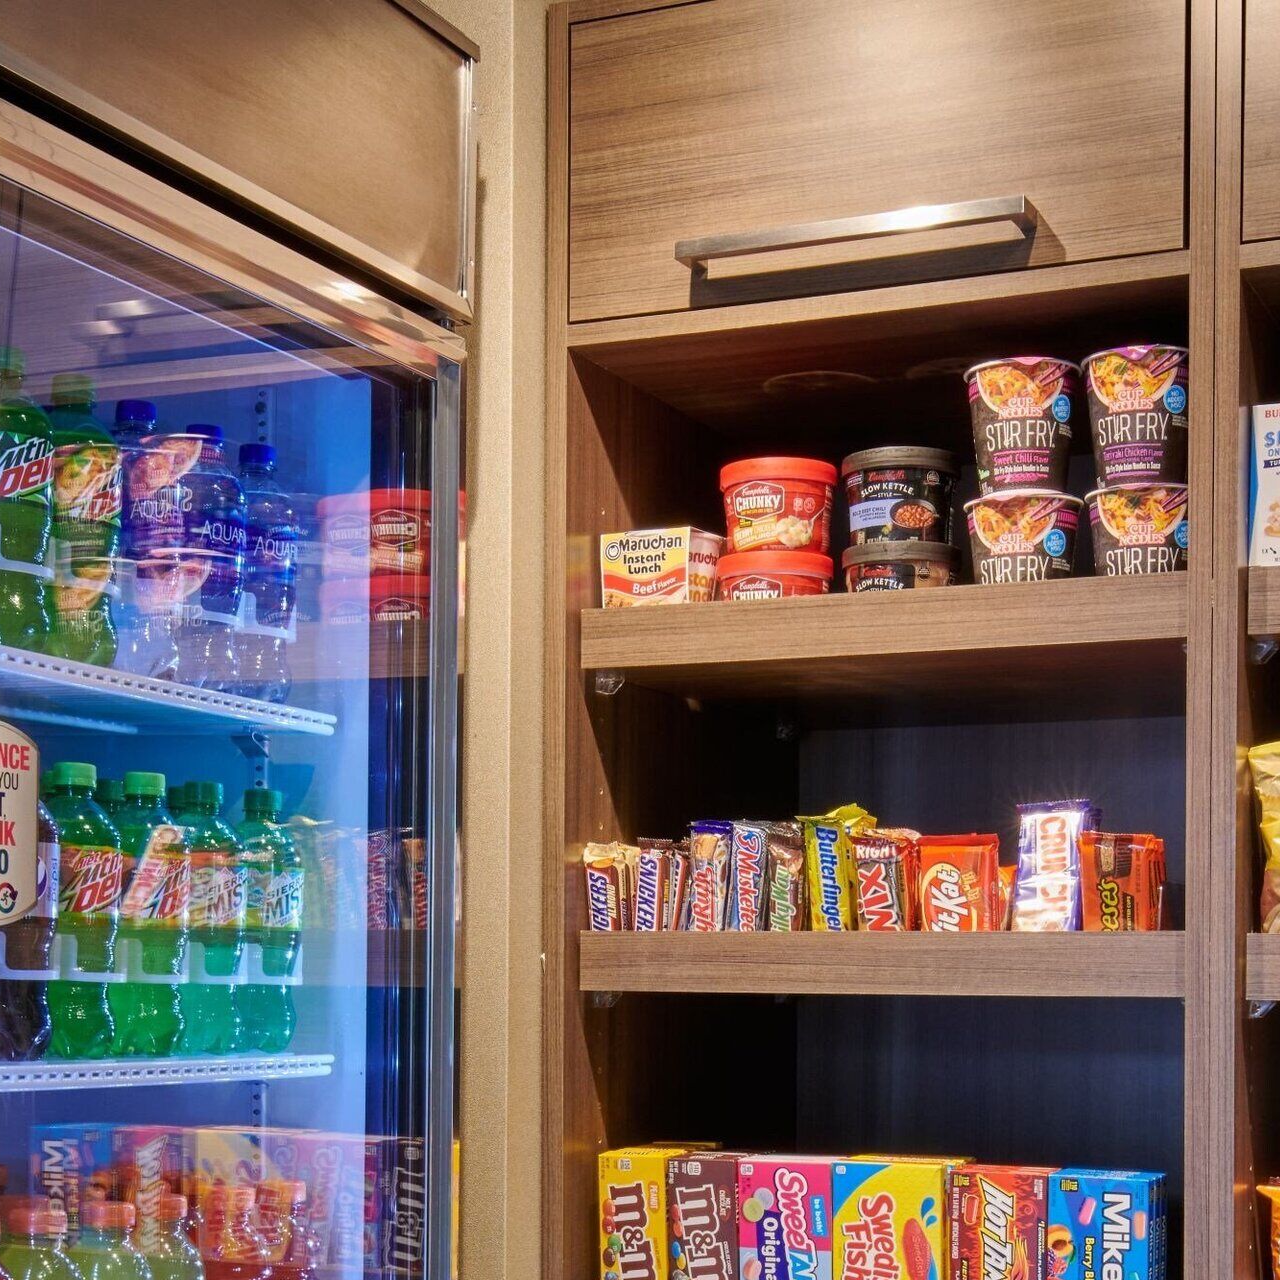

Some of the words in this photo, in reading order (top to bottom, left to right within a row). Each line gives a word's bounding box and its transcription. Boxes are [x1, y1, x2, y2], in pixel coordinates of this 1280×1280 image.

[1008, 396, 1033, 407] CUP
[985, 420, 1020, 452] STIR
[1026, 419, 1057, 448] FRY
[1267, 448, 1280, 457] ON
[861, 482, 880, 498] SLOW
[882, 482, 914, 496] KETTLE
[736, 494, 782, 512] CHUNKY
[619, 534, 682, 552] Maruchan
[623, 551, 666, 565] Instant
[628, 564, 661, 575] Lunch
[632, 581, 658, 594] Beef
[658, 577, 677, 589] Flavor
[1084, 1237, 1095, 1269] Berry
